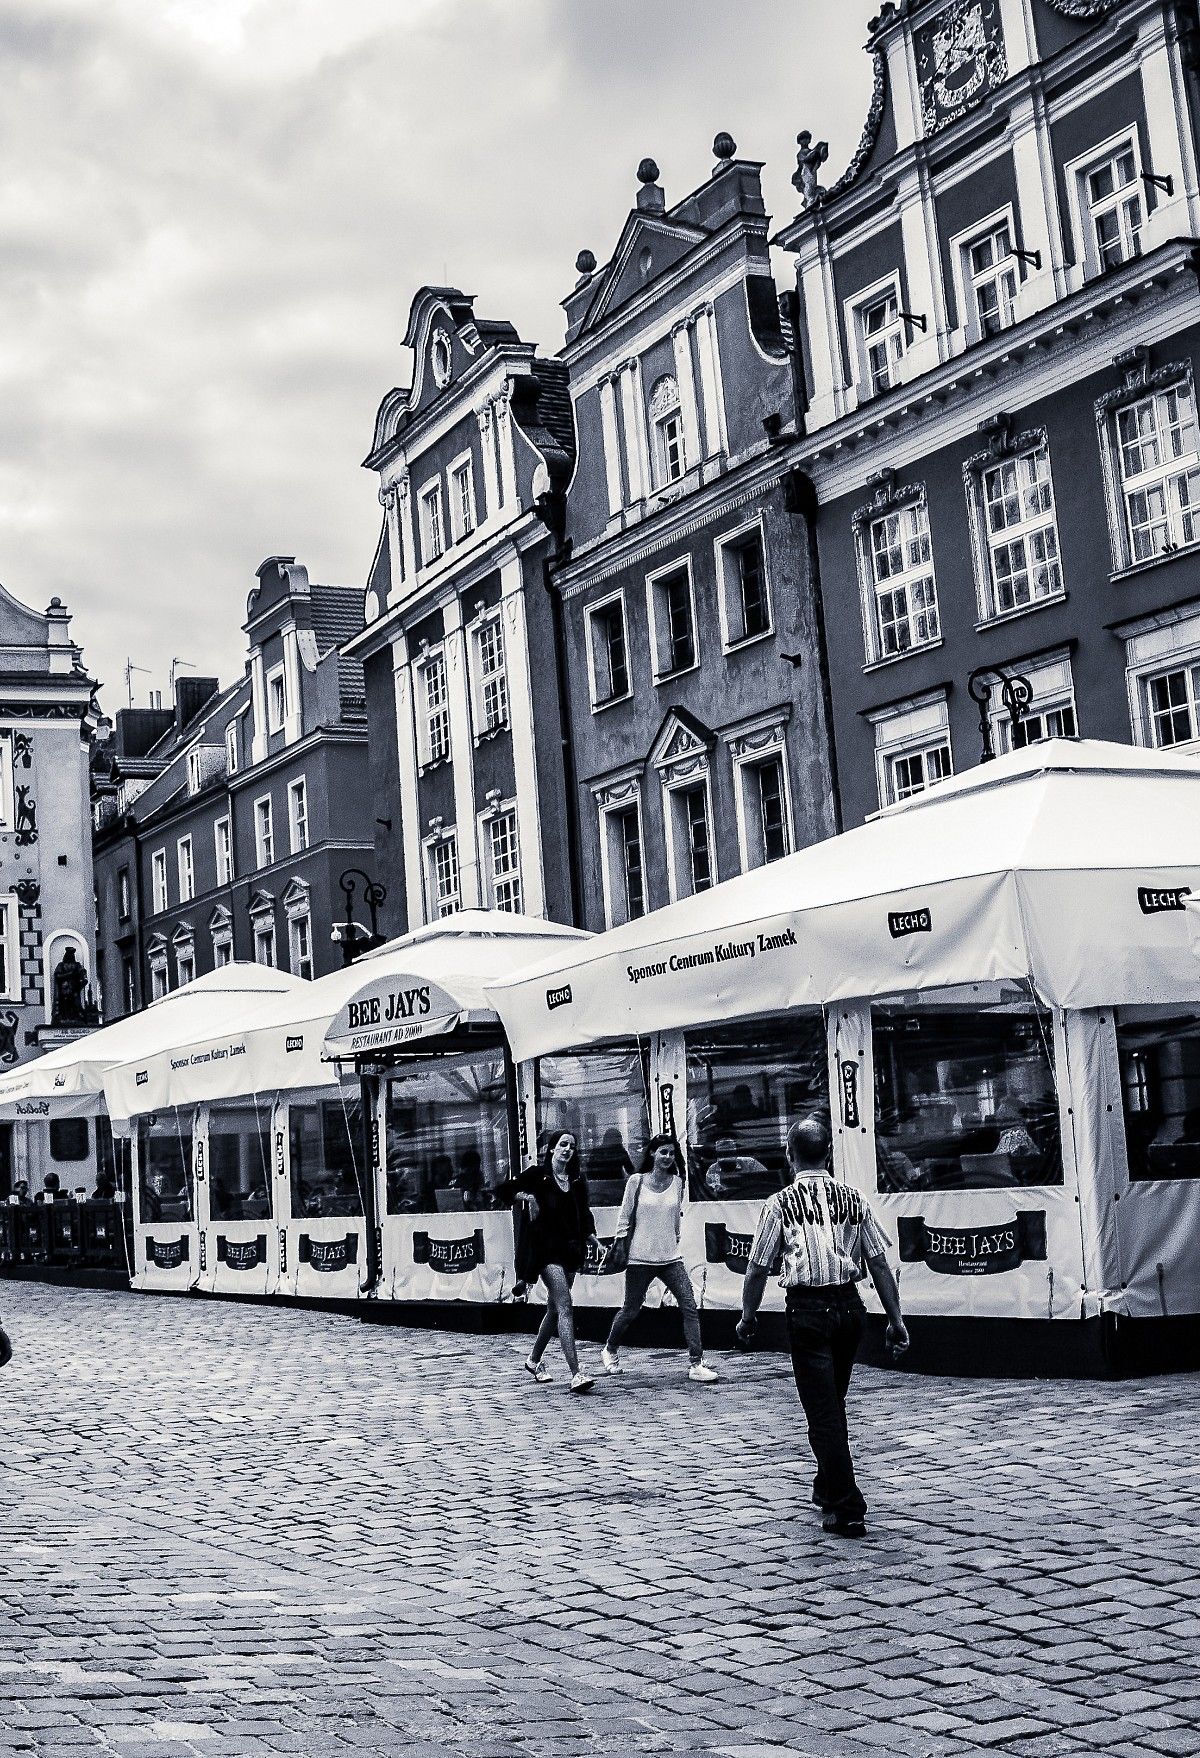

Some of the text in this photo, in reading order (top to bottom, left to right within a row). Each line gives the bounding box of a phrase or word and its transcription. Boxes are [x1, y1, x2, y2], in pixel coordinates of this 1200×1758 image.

[1143, 891, 1177, 906] LECH
[892, 914, 919, 932] LECH
[626, 928, 798, 984] Sponsor Centrum Kultury Zamek
[347, 986, 431, 1029] BEE JAY'S
[548, 991, 564, 1006] LECH
[351, 1024, 423, 1049] RESTAURANT AD 2000
[170, 1043, 247, 1071] Sponsor Centrum Kultury Zamek
[845, 1081, 855, 1120] LECH
[429, 1242, 448, 1259] BEE
[926, 1230, 966, 1255] BEE
